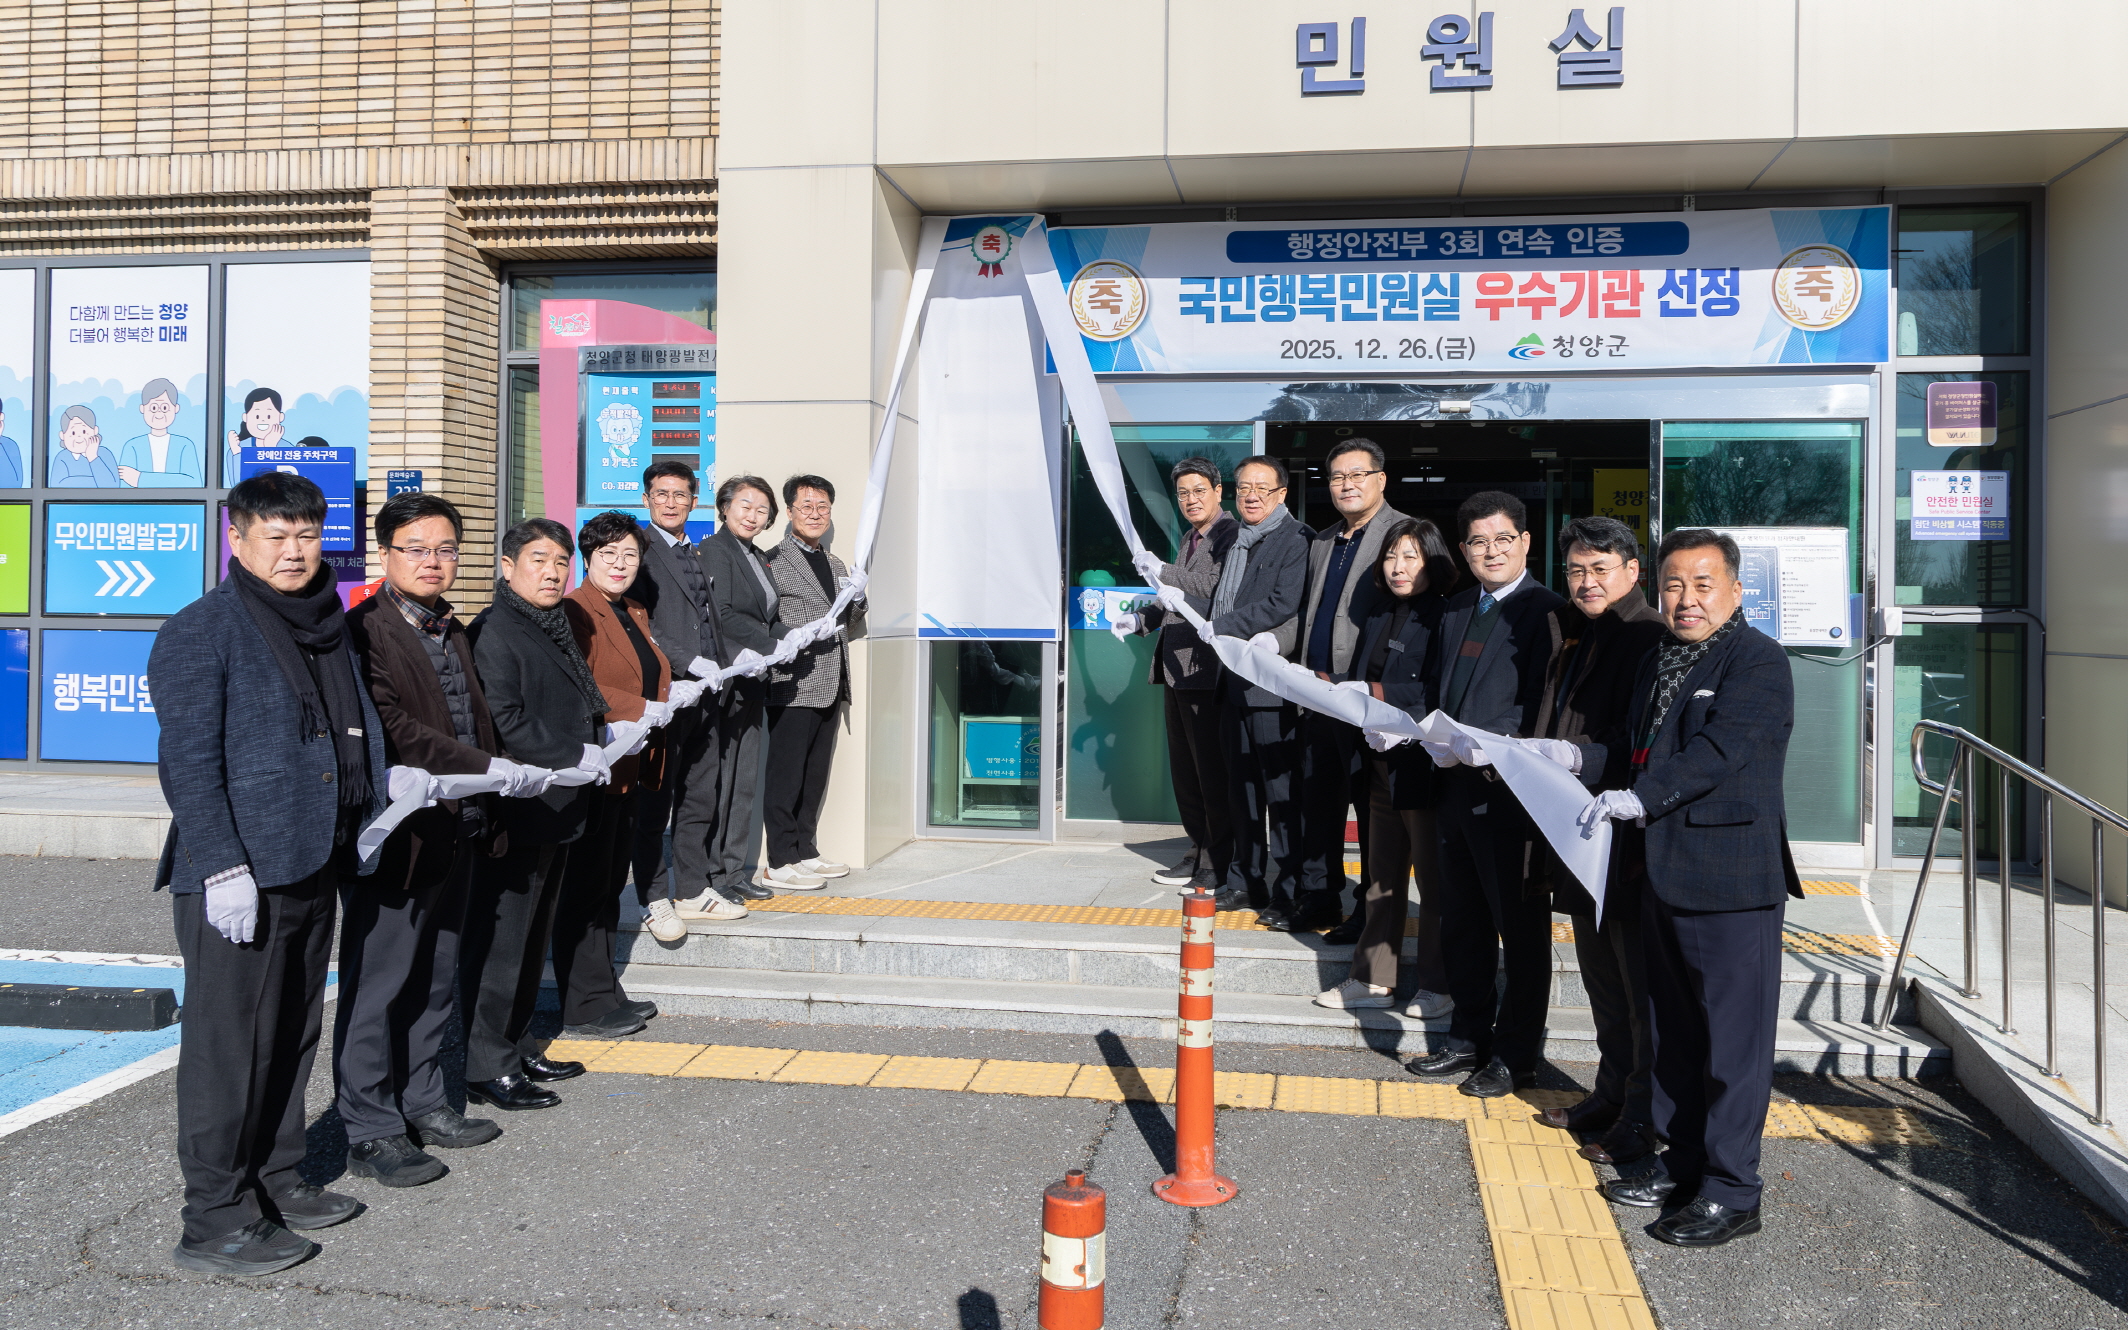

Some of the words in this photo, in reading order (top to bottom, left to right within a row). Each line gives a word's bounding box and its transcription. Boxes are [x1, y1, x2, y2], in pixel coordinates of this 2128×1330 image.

[982, 233, 1001, 253] 축
[1287, 227, 1428, 259] 행정안전부
[1438, 227, 1485, 257] 3회
[1496, 226, 1555, 256] 연속
[1566, 226, 1625, 255] 인증
[1178, 272, 1461, 324] 국민행복민원실
[1475, 268, 1644, 321] 우수기관
[1657, 266, 1740, 318] 선정
[1793, 264, 1834, 303] 축
[1087, 279, 1124, 315] 축
[69, 304, 110, 322] 다함께
[113, 303, 155, 321] 만드는
[158, 302, 189, 321] 청양
[69, 327, 110, 344] 더불어
[113, 325, 155, 343] 행복한
[158, 324, 188, 343] 미래
[586, 350, 636, 365] 청양군청
[641, 349, 717, 364] 태양광발전
[1280, 338, 1343, 361] 2025.
[1353, 338, 1388, 360] 12.
[1398, 336, 1477, 362] 26.(금)
[1552, 333, 1631, 359] 청양군
[256, 450, 283, 461] 장애인
[284, 450, 302, 461] 전용
[303, 450, 338, 461] 주차구역
[1926, 496, 1959, 508] 안전한
[1961, 496, 1994, 508] 민원실
[54, 522, 198, 551] 무인민원발급기
[347, 556, 366, 568] 처리
